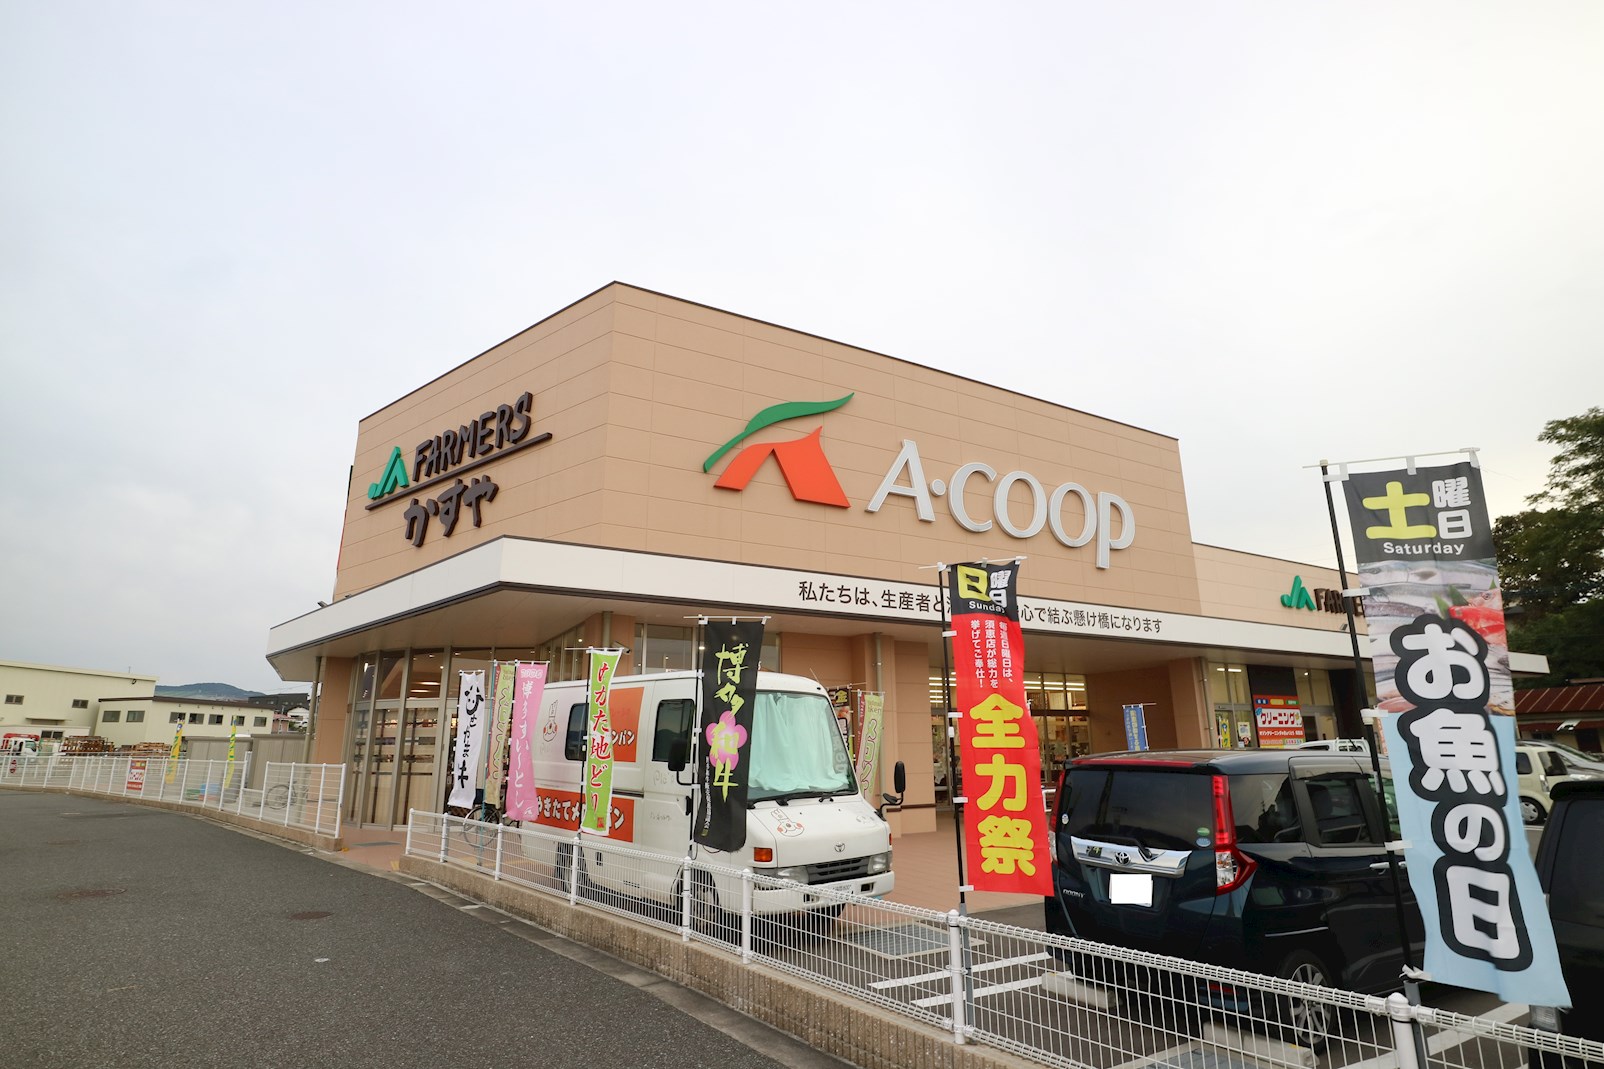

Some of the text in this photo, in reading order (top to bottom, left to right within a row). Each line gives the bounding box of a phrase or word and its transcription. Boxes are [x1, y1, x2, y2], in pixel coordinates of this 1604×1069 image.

[412, 391, 533, 481] FARMERS
[402, 474, 500, 548] かすや
[1382, 541, 1465, 555] Saturday
[984, 619, 999, 689] 須恵店が総力を
[610, 728, 636, 747] ンパン
[711, 642, 750, 804] 博多和牛
[1260, 711, 1296, 725] クリーニング
[969, 692, 1036, 877] 全力祭
[1399, 620, 1522, 963] お魚の日
